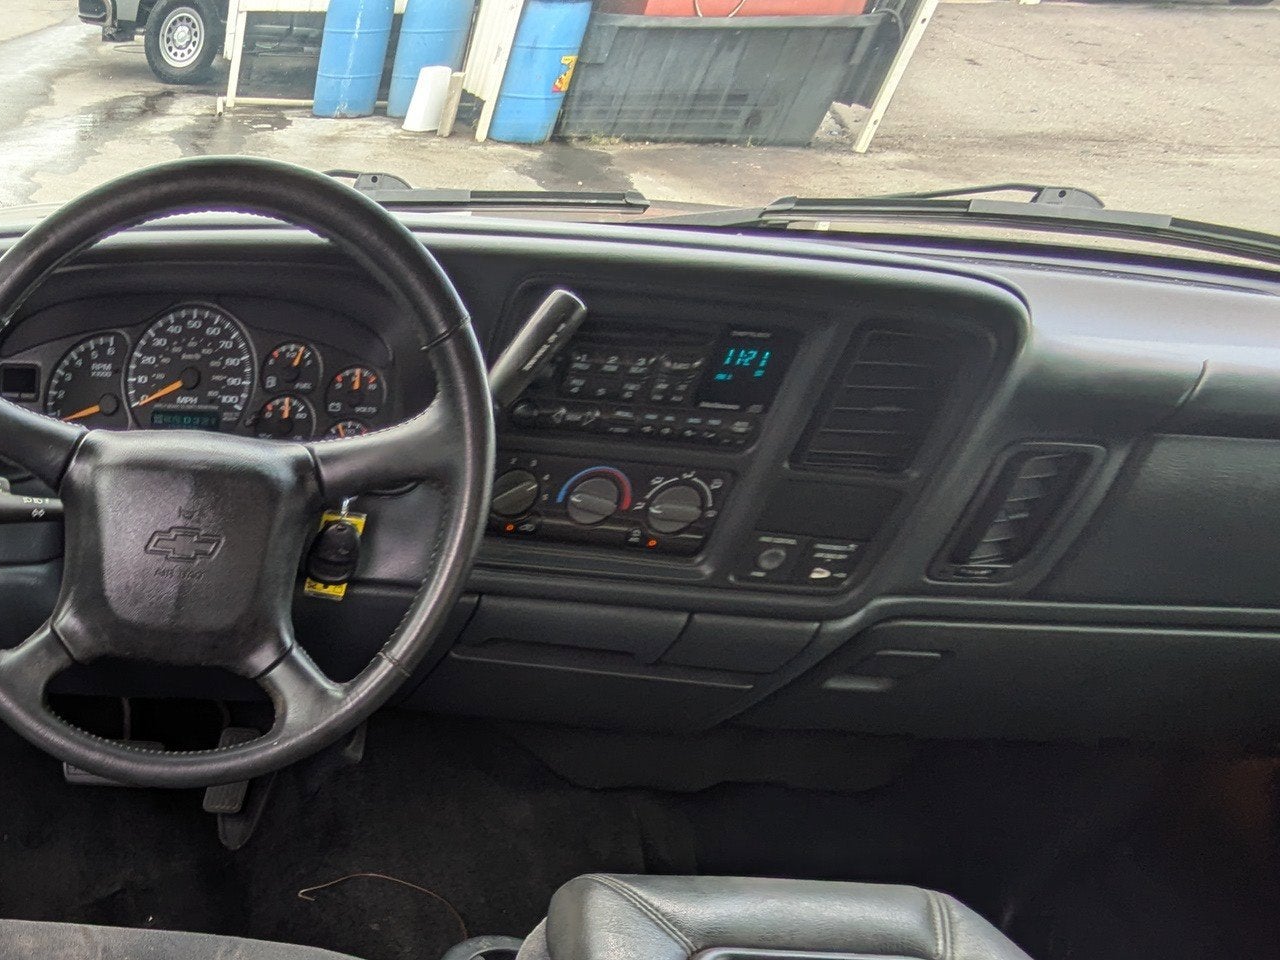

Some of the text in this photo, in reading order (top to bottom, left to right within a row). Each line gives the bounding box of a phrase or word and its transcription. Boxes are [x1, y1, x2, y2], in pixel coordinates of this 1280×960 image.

[166, 325, 183, 334] 40
[205, 327, 221, 336] 60
[152, 338, 168, 347] 30
[219, 340, 234, 349] 70
[140, 356, 156, 365] 20
[137, 374, 149, 384] 10
[226, 377, 242, 386] 90
[176, 396, 198, 404] MPH
[220, 395, 239, 404] 100
